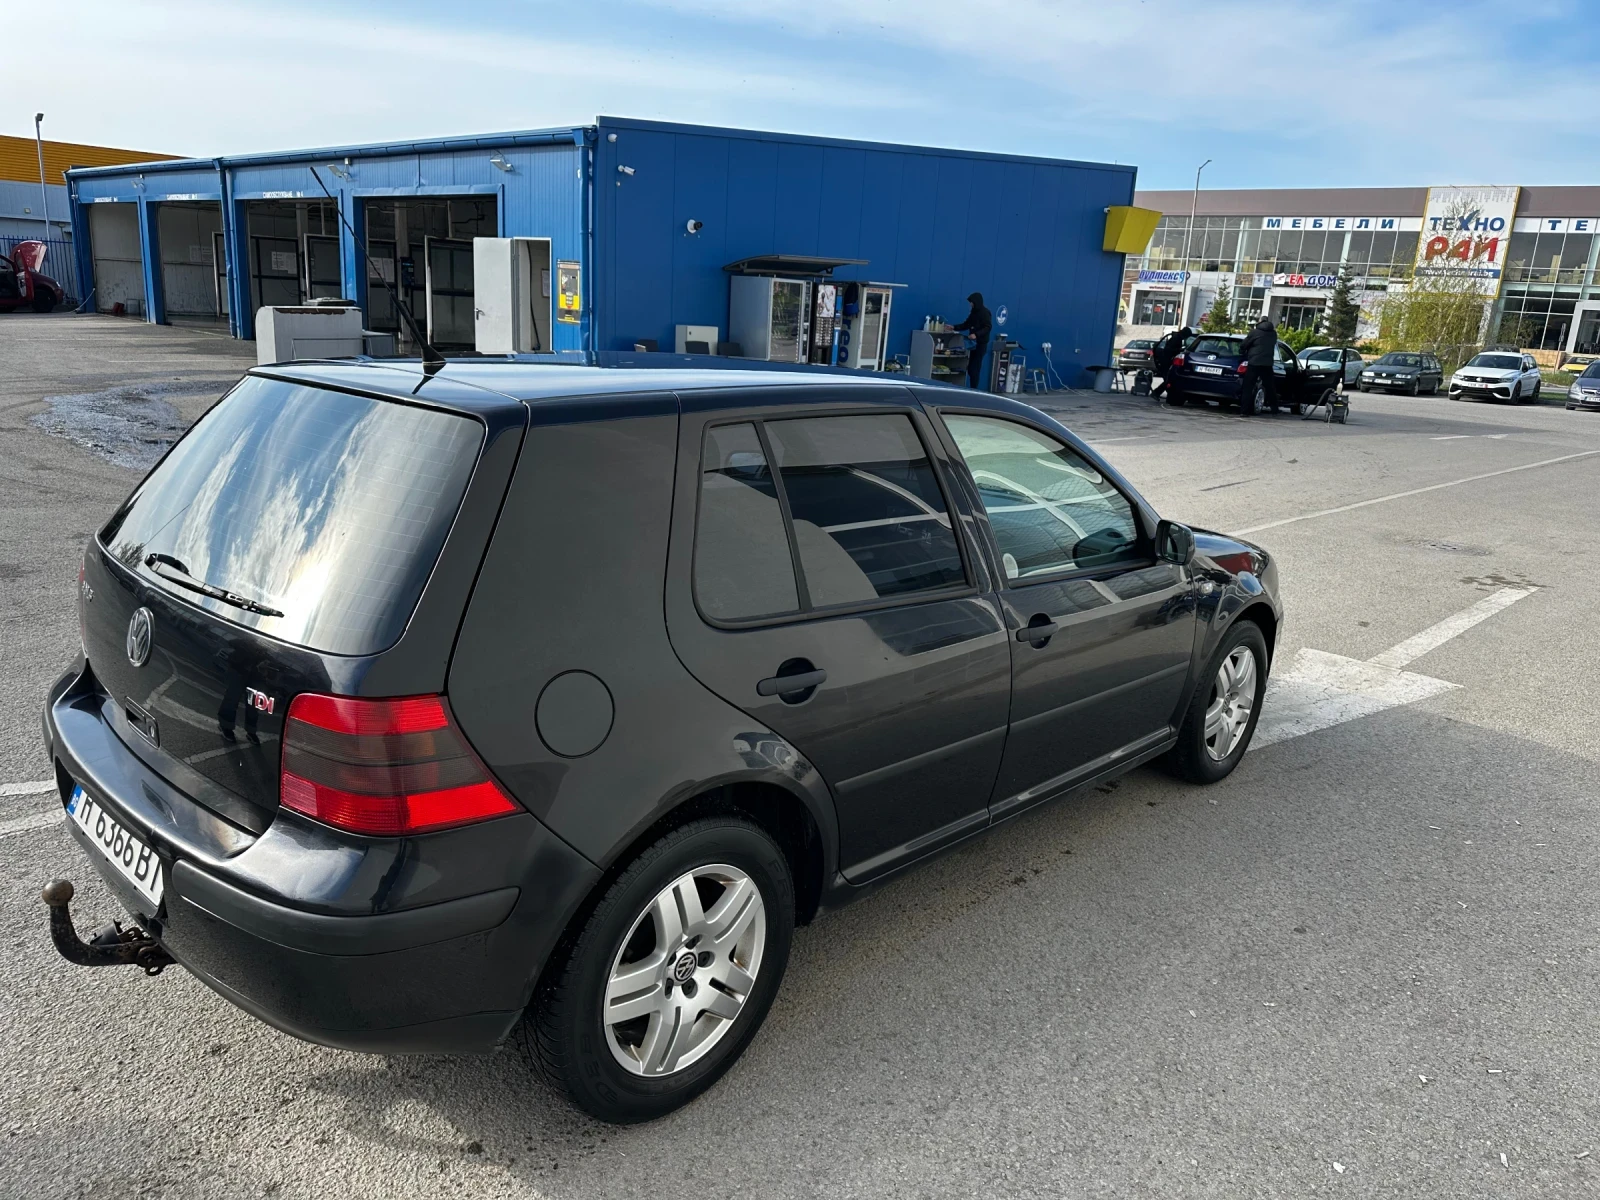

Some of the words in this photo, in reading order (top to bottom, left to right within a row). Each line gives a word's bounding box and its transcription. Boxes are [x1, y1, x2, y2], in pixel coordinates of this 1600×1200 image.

[1266, 218, 1394, 229] МЕБЕЛИ
[1429, 209, 1505, 232] ТЕХНО
[1425, 235, 1499, 262] РАЙ
[246, 686, 275, 715] TDI
